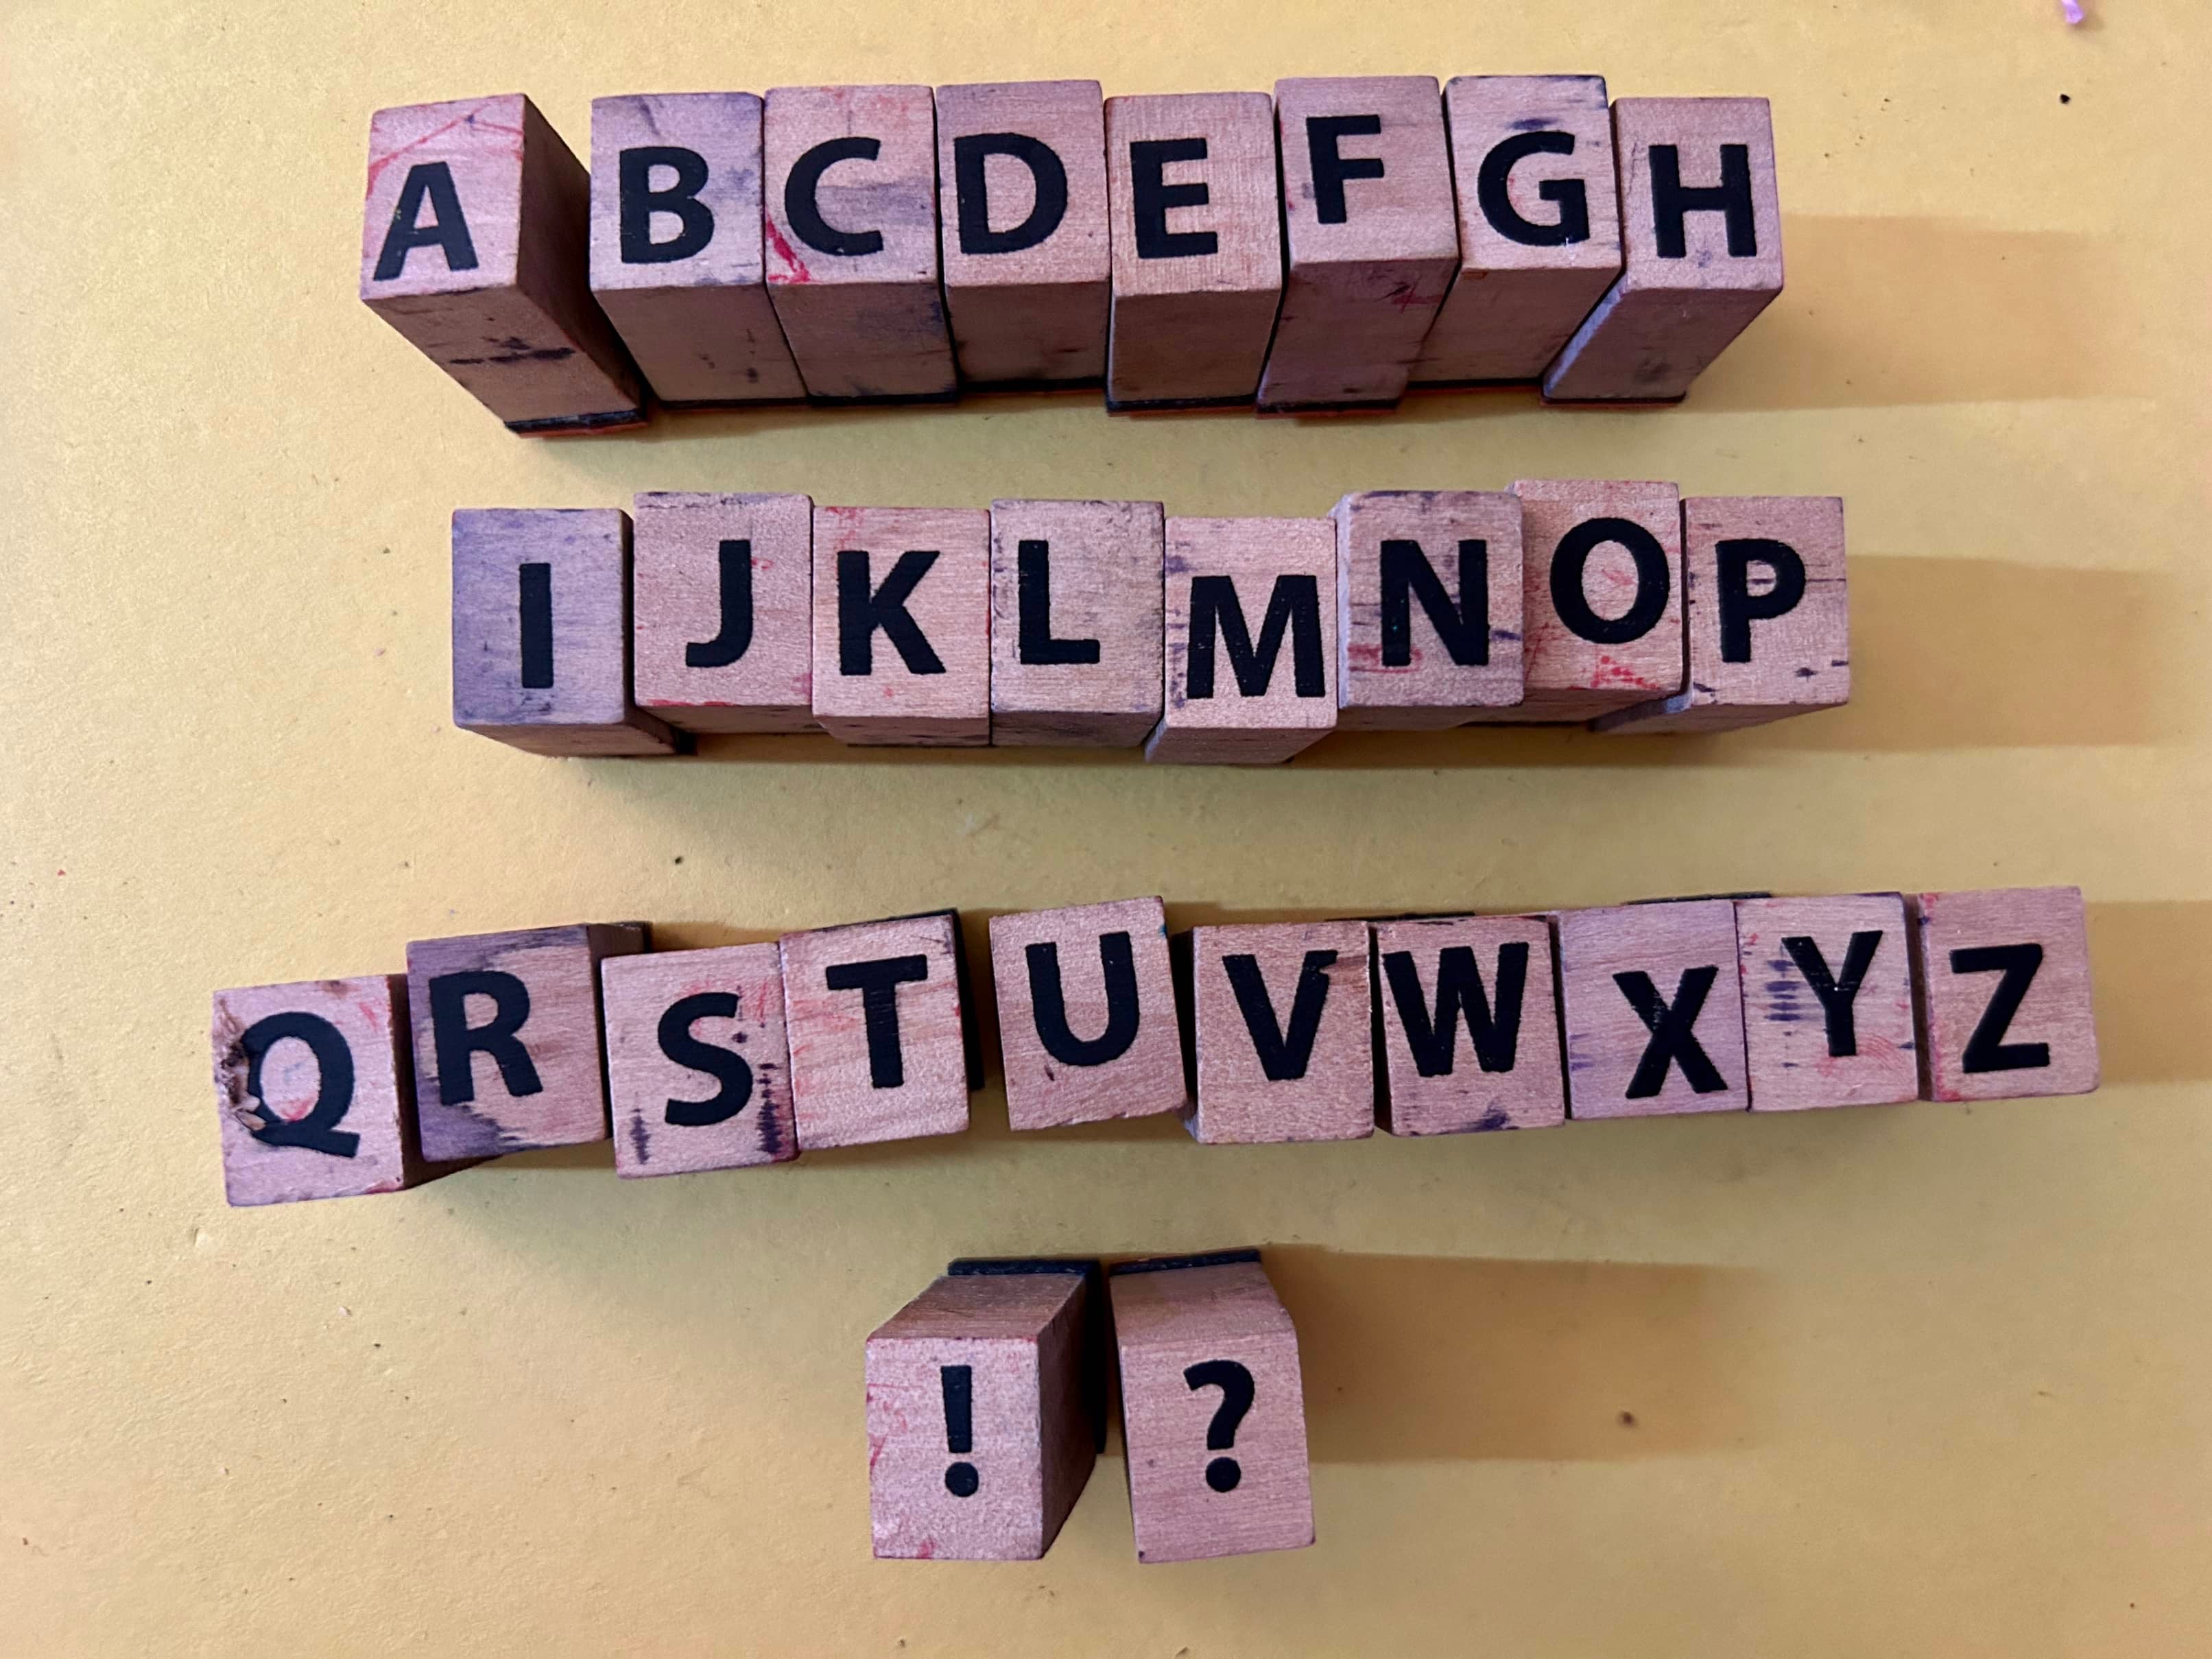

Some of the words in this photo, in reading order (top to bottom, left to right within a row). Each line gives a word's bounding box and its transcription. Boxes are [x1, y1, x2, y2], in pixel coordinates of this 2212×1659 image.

[374, 162, 477, 280] A
[620, 147, 714, 263] B
[785, 137, 883, 256] C
[954, 132, 1068, 254] D
[1130, 138, 1217, 259] E
[1307, 115, 1384, 224] F
[1478, 131, 1590, 246] G
[1649, 144, 1757, 258] H
[519, 563, 554, 689] I
[686, 540, 753, 668] J
[837, 551, 946, 676] K
[1018, 540, 1100, 665] L
[1187, 575, 1325, 699] M
[1379, 539, 1490, 667] N
[1549, 517, 1670, 644] O
[1715, 538, 1807, 663] P
[237, 1012, 359, 1156] Q
[433, 968, 543, 1107] R
[658, 992, 753, 1126] S
[826, 955, 927, 1088] T
[1025, 931, 1140, 1066] U
[1222, 950, 1338, 1081] V
[1382, 942, 1529, 1077] W
[1613, 965, 1728, 1099] X
[1782, 931, 1883, 1058] Y
[1950, 943, 2050, 1073] Z
[941, 1365, 979, 1497] !
[1184, 1361, 1254, 1492] ?
